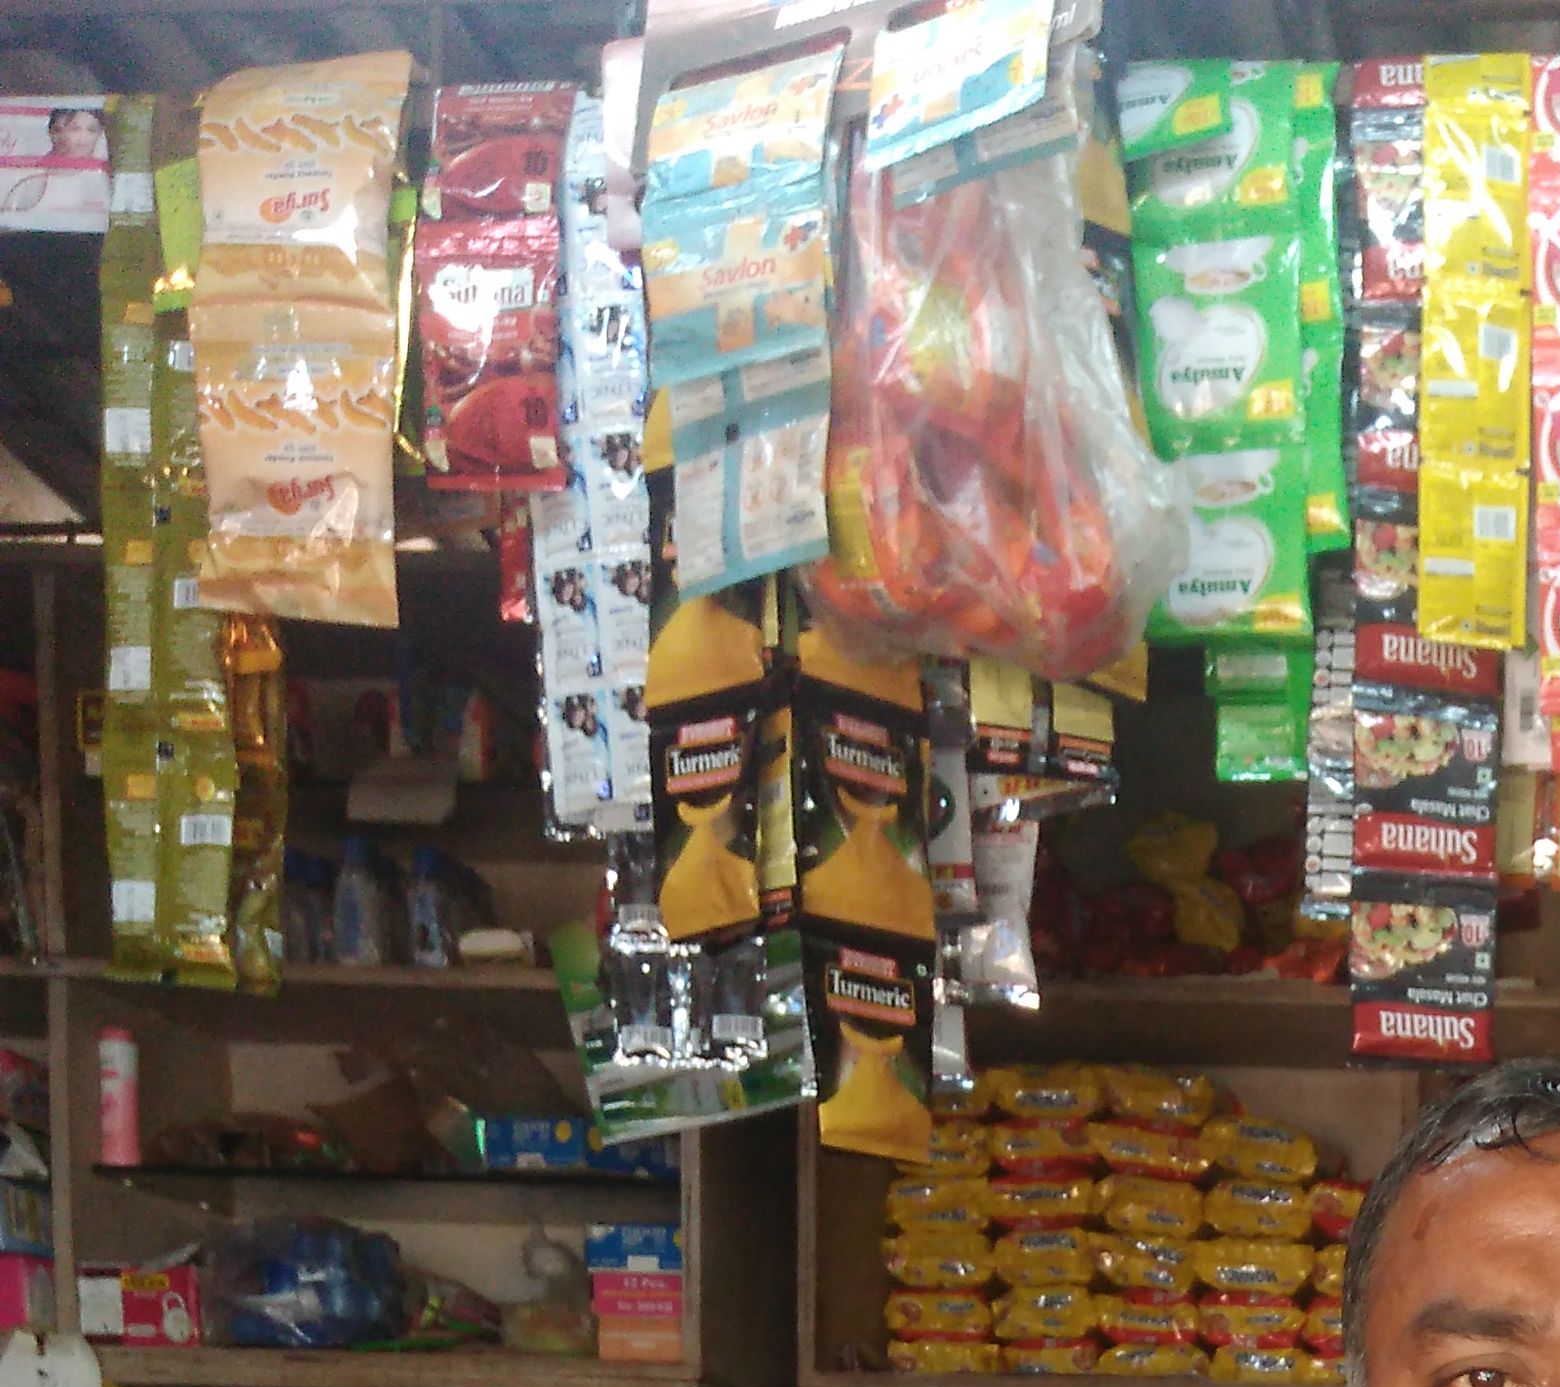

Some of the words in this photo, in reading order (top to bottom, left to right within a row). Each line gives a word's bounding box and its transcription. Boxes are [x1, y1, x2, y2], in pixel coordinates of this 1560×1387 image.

[701, 100, 779, 133] Savlon
[1164, 153, 1238, 175] Amulya
[702, 256, 776, 287] Savlon
[1170, 366, 1244, 384] Amulya
[1178, 578, 1251, 596] Amulya
[1382, 633, 1478, 680] Suhana
[670, 745, 741, 776] Turmeric
[828, 731, 901, 777] Turmeric
[1381, 822, 1478, 865] Suhana
[830, 968, 910, 1010] Turmeric
[1379, 1011, 1476, 1050] Suhana
